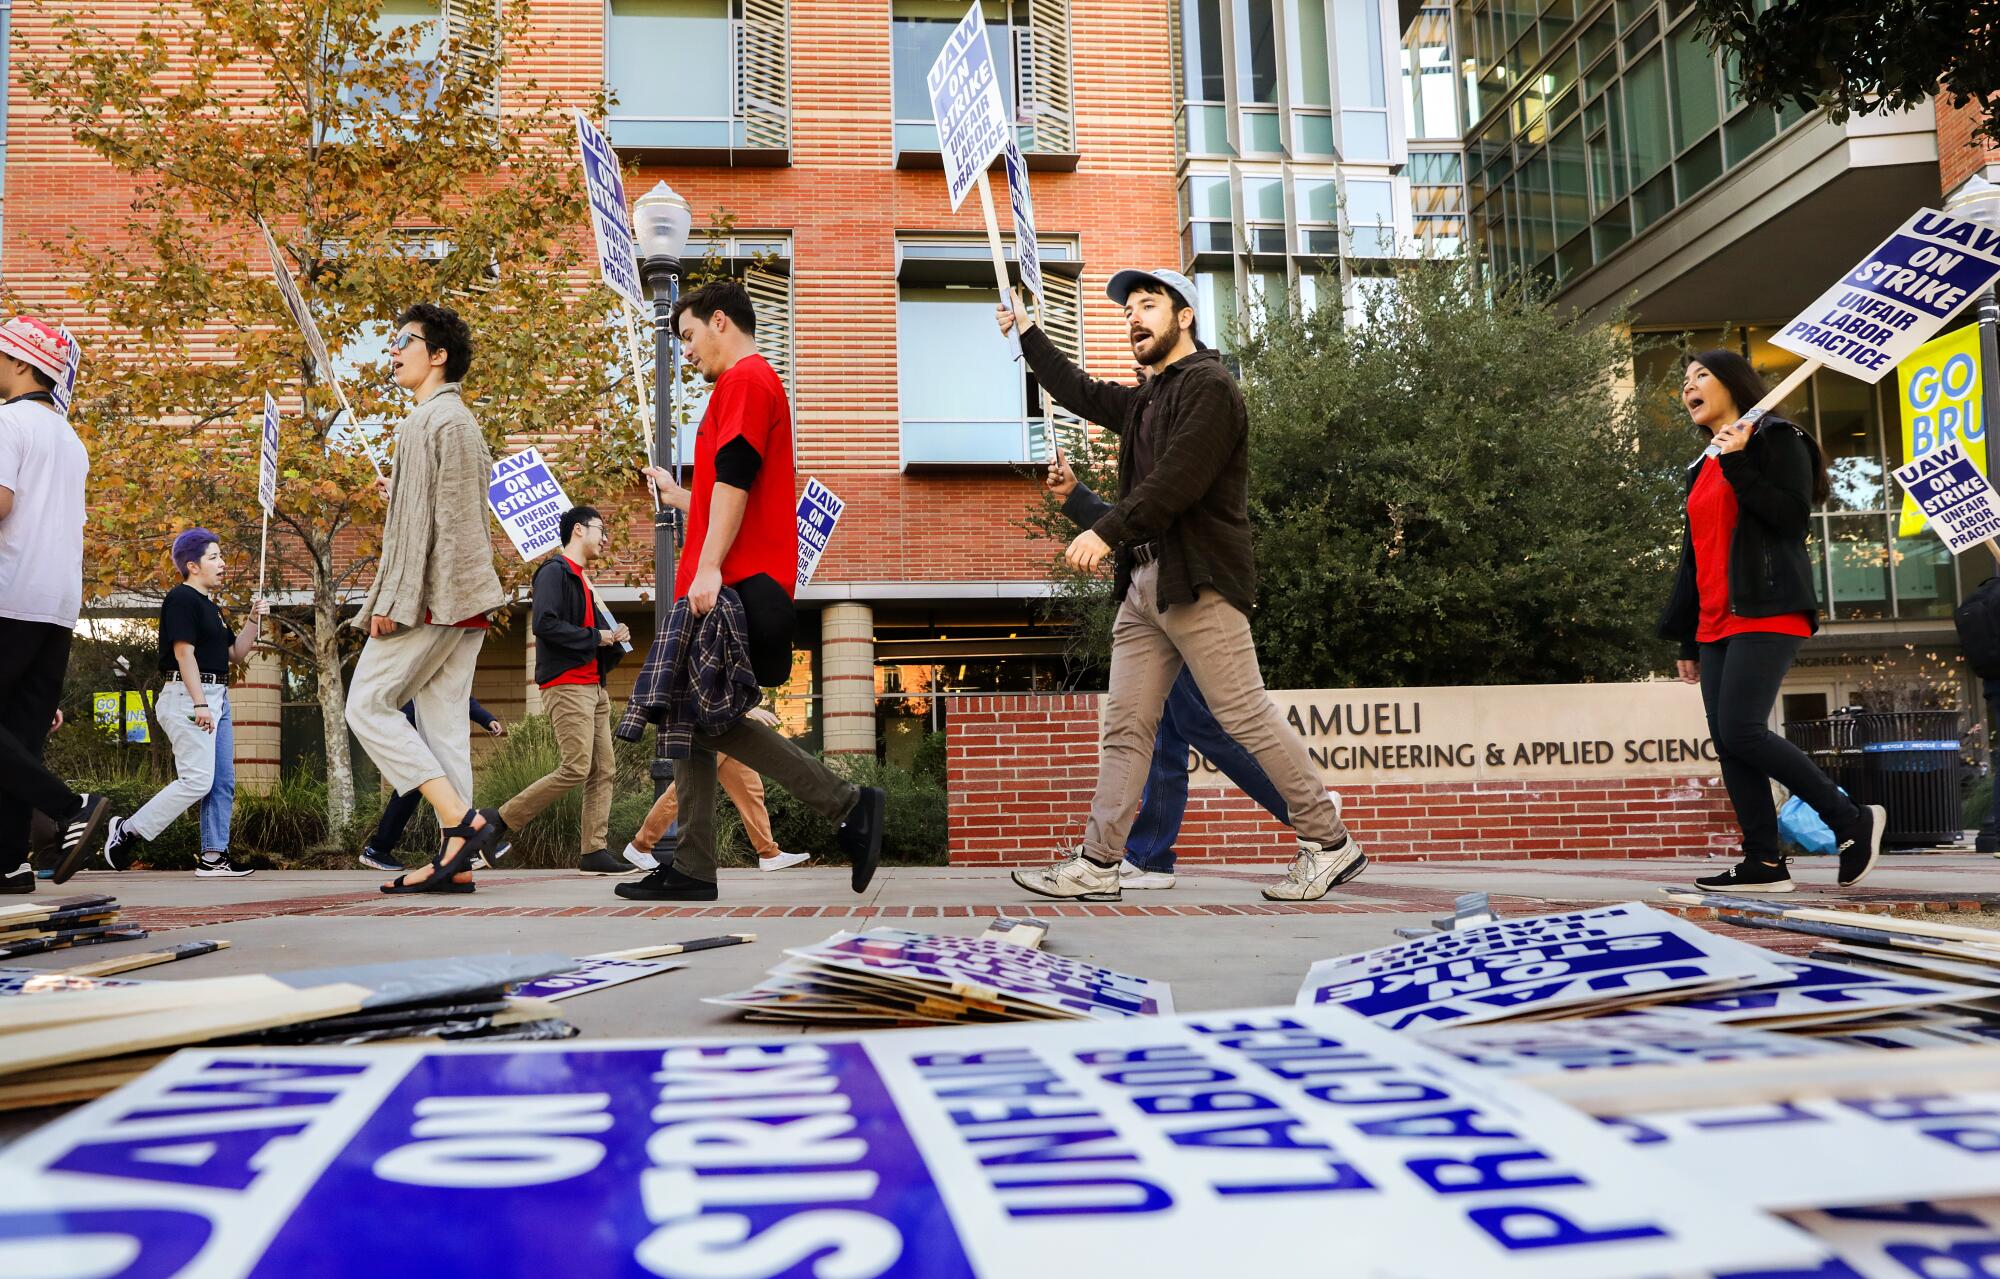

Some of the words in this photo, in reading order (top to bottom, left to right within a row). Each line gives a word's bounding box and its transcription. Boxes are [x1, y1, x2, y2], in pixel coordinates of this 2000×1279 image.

[929, 6, 979, 92] UAW
[948, 57, 970, 97] ON
[941, 60, 991, 141] STRIKE
[579, 115, 618, 174] UAW
[951, 94, 990, 156] UNFAIR
[956, 114, 992, 172] LABOR
[597, 160, 616, 197] ON
[952, 120, 1005, 201] PRACTICE
[590, 176, 630, 232] STRIKE
[600, 217, 633, 260] UNFAIR
[606, 240, 635, 281] LABOR
[1908, 247, 1964, 277] ON
[603, 256, 645, 309] PRACTICE
[1855, 261, 1967, 311] STRIKE
[1819, 310, 1894, 347] LABOR
[1837, 292, 1919, 331] UNFAIR
[1785, 321, 1892, 371] PRACTICE
[1908, 353, 1977, 412] GO
[504, 472, 532, 494] ON
[1899, 445, 1959, 484] UAW
[1930, 470, 1956, 492] ON
[497, 480, 556, 515] STRIKE
[514, 501, 560, 527] UNFAIR
[807, 481, 842, 516] UAW
[1923, 476, 1985, 516] STRIKE
[1941, 496, 1989, 524] UNFAIR
[808, 508, 825, 528] ON
[1950, 517, 2000, 548] PRACTIC
[1951, 508, 1995, 534] LABOR
[97, 699, 116, 711] GO
[1286, 702, 1421, 736] AMUELI
[1308, 744, 1475, 770] NGINEERING
[1485, 742, 1505, 766] &
[1513, 740, 1614, 766] APPLIED
[1624, 738, 1719, 763] SCIENC
[1325, 935, 1664, 1004] STRIKE
[1427, 961, 1571, 1001] ON
[373, 1092, 614, 1187] ON
[910, 1048, 1176, 1217] UNFAIR
[1073, 1045, 1378, 1196] LABOR
[1187, 1018, 1668, 1250] PRACTICE
[634, 1045, 903, 1279] STRIKE
